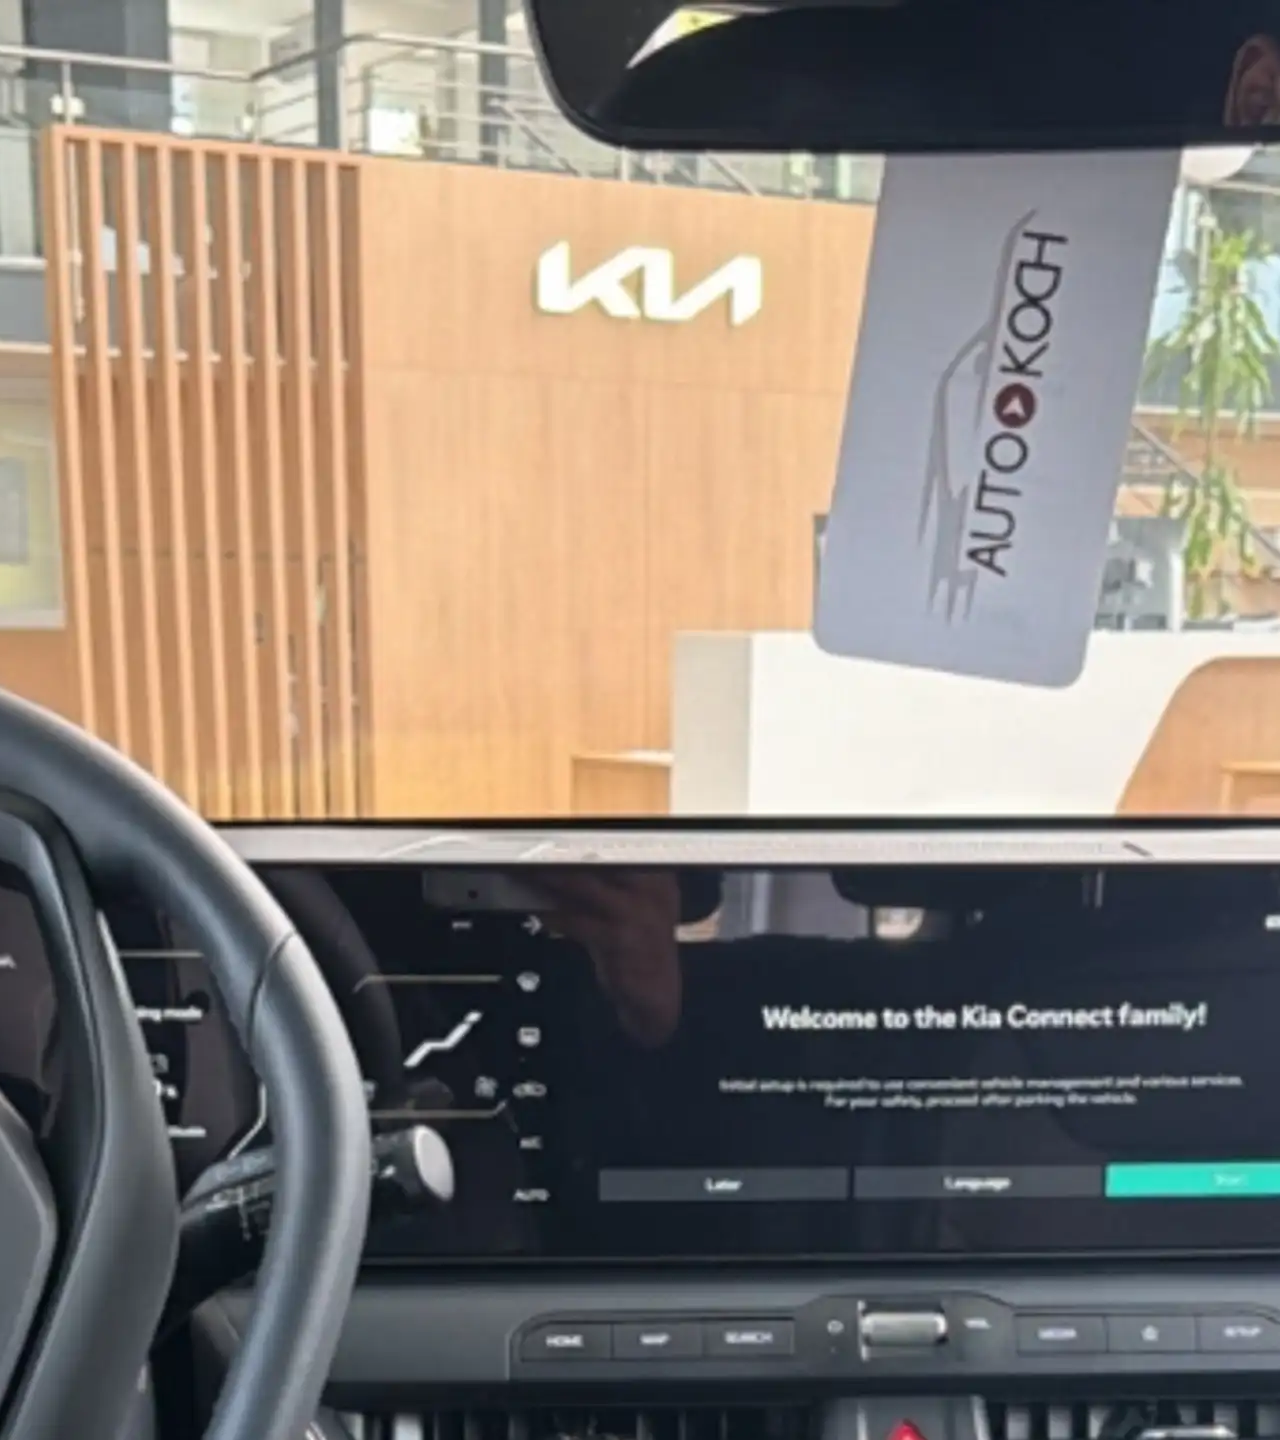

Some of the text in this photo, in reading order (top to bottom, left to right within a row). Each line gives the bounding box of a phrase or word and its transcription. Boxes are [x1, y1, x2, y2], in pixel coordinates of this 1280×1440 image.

[537, 241, 762, 325] KIA
[967, 229, 1068, 577] AUTO KOCH
[762, 1002, 1208, 1031] Welcome to the Kia Connect family!
[1026, 1077, 1114, 1092] management
[704, 1177, 742, 1192] Later
[943, 1175, 1012, 1192] Language
[545, 1333, 584, 1348] HOME
[725, 1330, 773, 1345] SEARCH
